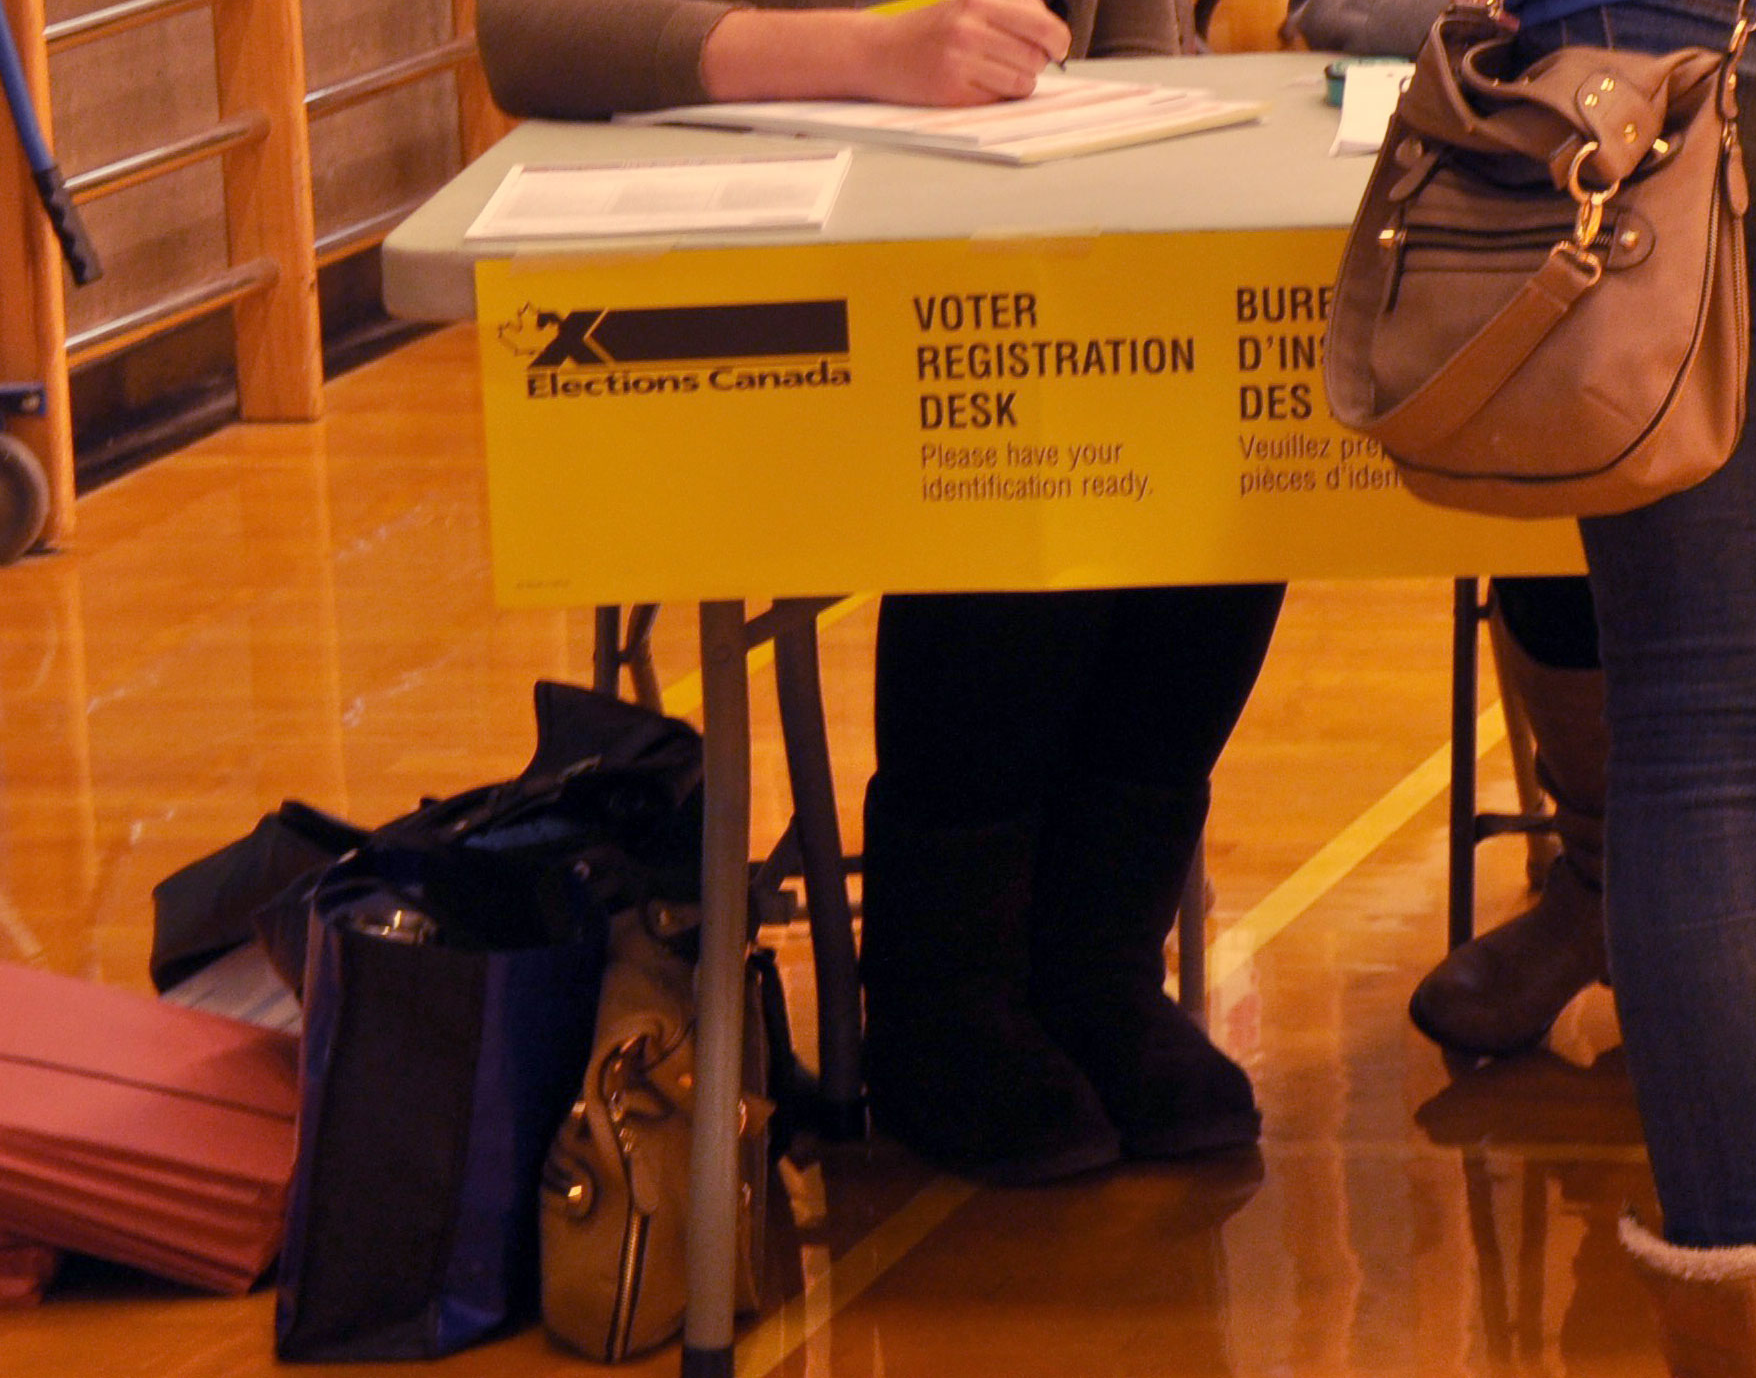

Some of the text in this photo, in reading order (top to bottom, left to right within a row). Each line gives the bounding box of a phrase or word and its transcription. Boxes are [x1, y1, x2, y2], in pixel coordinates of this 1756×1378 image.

[912, 293, 1037, 332] VOTER
[916, 338, 1195, 380] REGISTRATION
[527, 361, 852, 399] Elections Canada
[919, 393, 1017, 430] DESK
[1239, 383, 1313, 421] DES
[920, 441, 1124, 472] Please have your
[1238, 433, 1331, 461] Veuillez
[922, 468, 1153, 502] identification ready.
[1240, 465, 1317, 497] pièces
